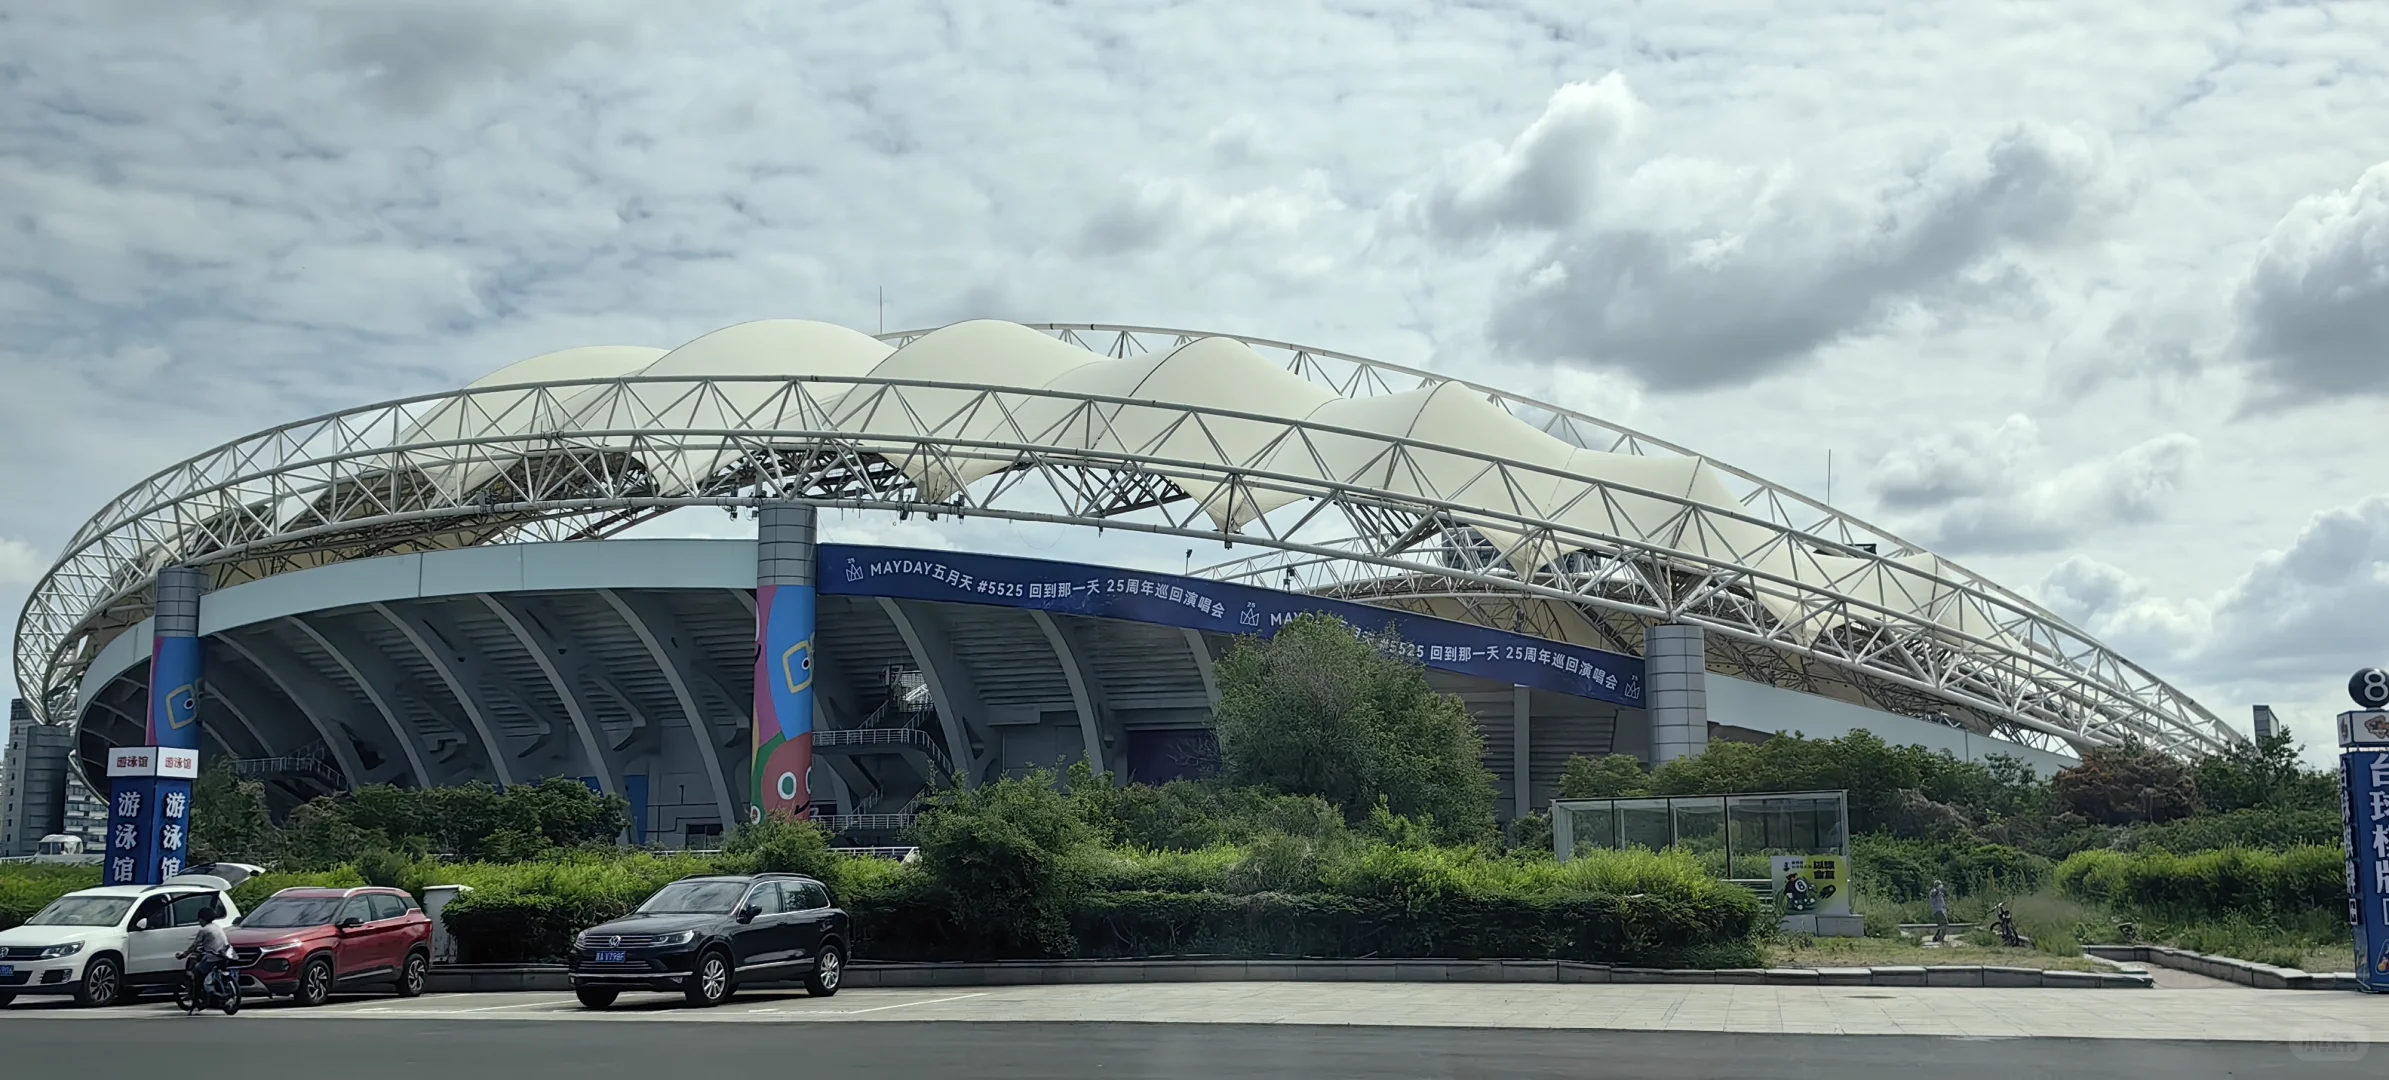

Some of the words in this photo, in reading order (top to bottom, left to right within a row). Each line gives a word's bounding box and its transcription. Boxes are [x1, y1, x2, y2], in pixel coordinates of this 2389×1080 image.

[870, 560, 974, 591] MAYDAY五月天
[977, 580, 1023, 597] #5525
[1107, 578, 1226, 619] 25周年巡回演唱会
[1506, 646, 1619, 691] 25周年巡回演唱会
[2364, 670, 2389, 701] 8
[113, 791, 141, 882] 游泳馆
[161, 792, 186, 882] 游泳馆
